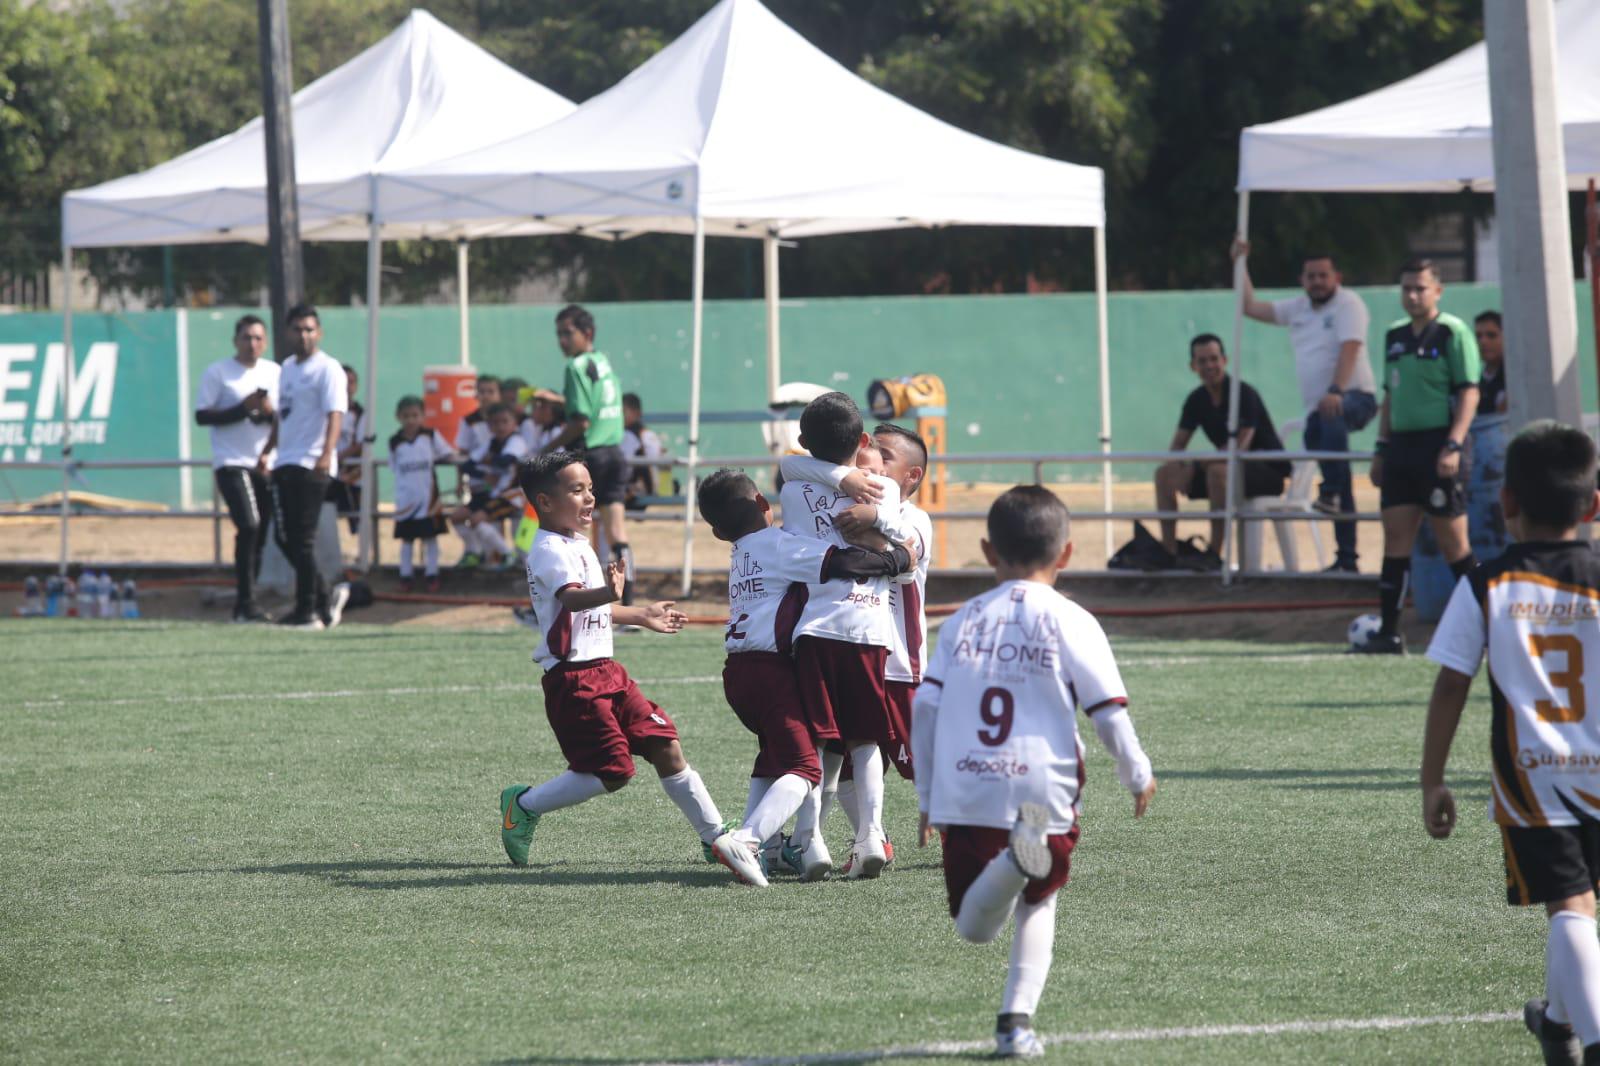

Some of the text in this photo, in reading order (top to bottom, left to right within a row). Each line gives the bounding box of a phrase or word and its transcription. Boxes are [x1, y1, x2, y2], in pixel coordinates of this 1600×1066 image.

[953, 639, 1060, 669] AHOME
[1528, 634, 1586, 723] 3
[977, 686, 1015, 747] 9
[898, 743, 909, 765] 4
